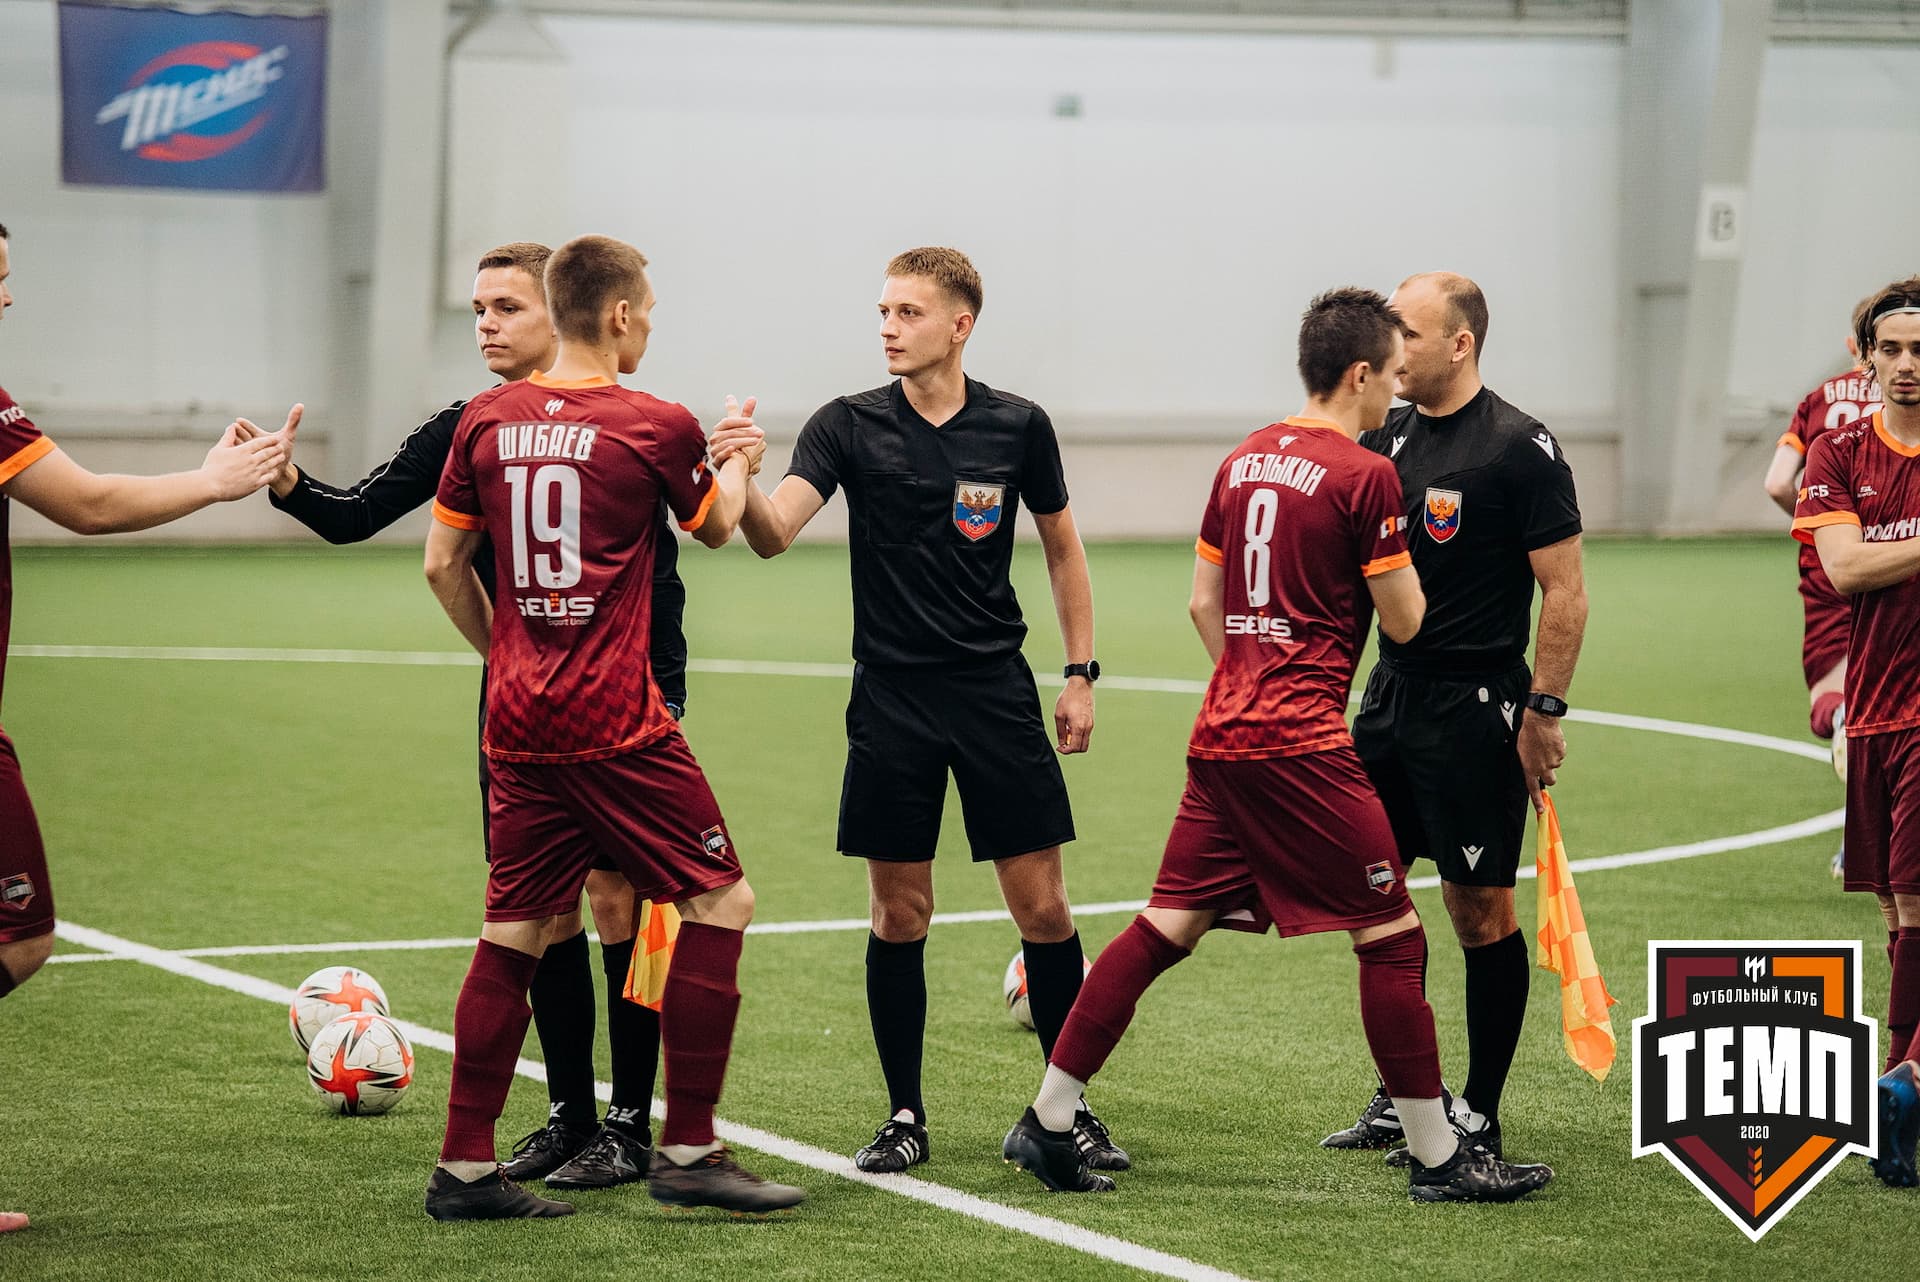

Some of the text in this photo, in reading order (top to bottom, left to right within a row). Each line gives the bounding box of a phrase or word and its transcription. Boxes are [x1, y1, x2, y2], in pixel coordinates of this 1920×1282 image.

[499, 424, 596, 461] ШИБАЕВ
[504, 464, 582, 589] 19
[1244, 488, 1278, 607] 8
